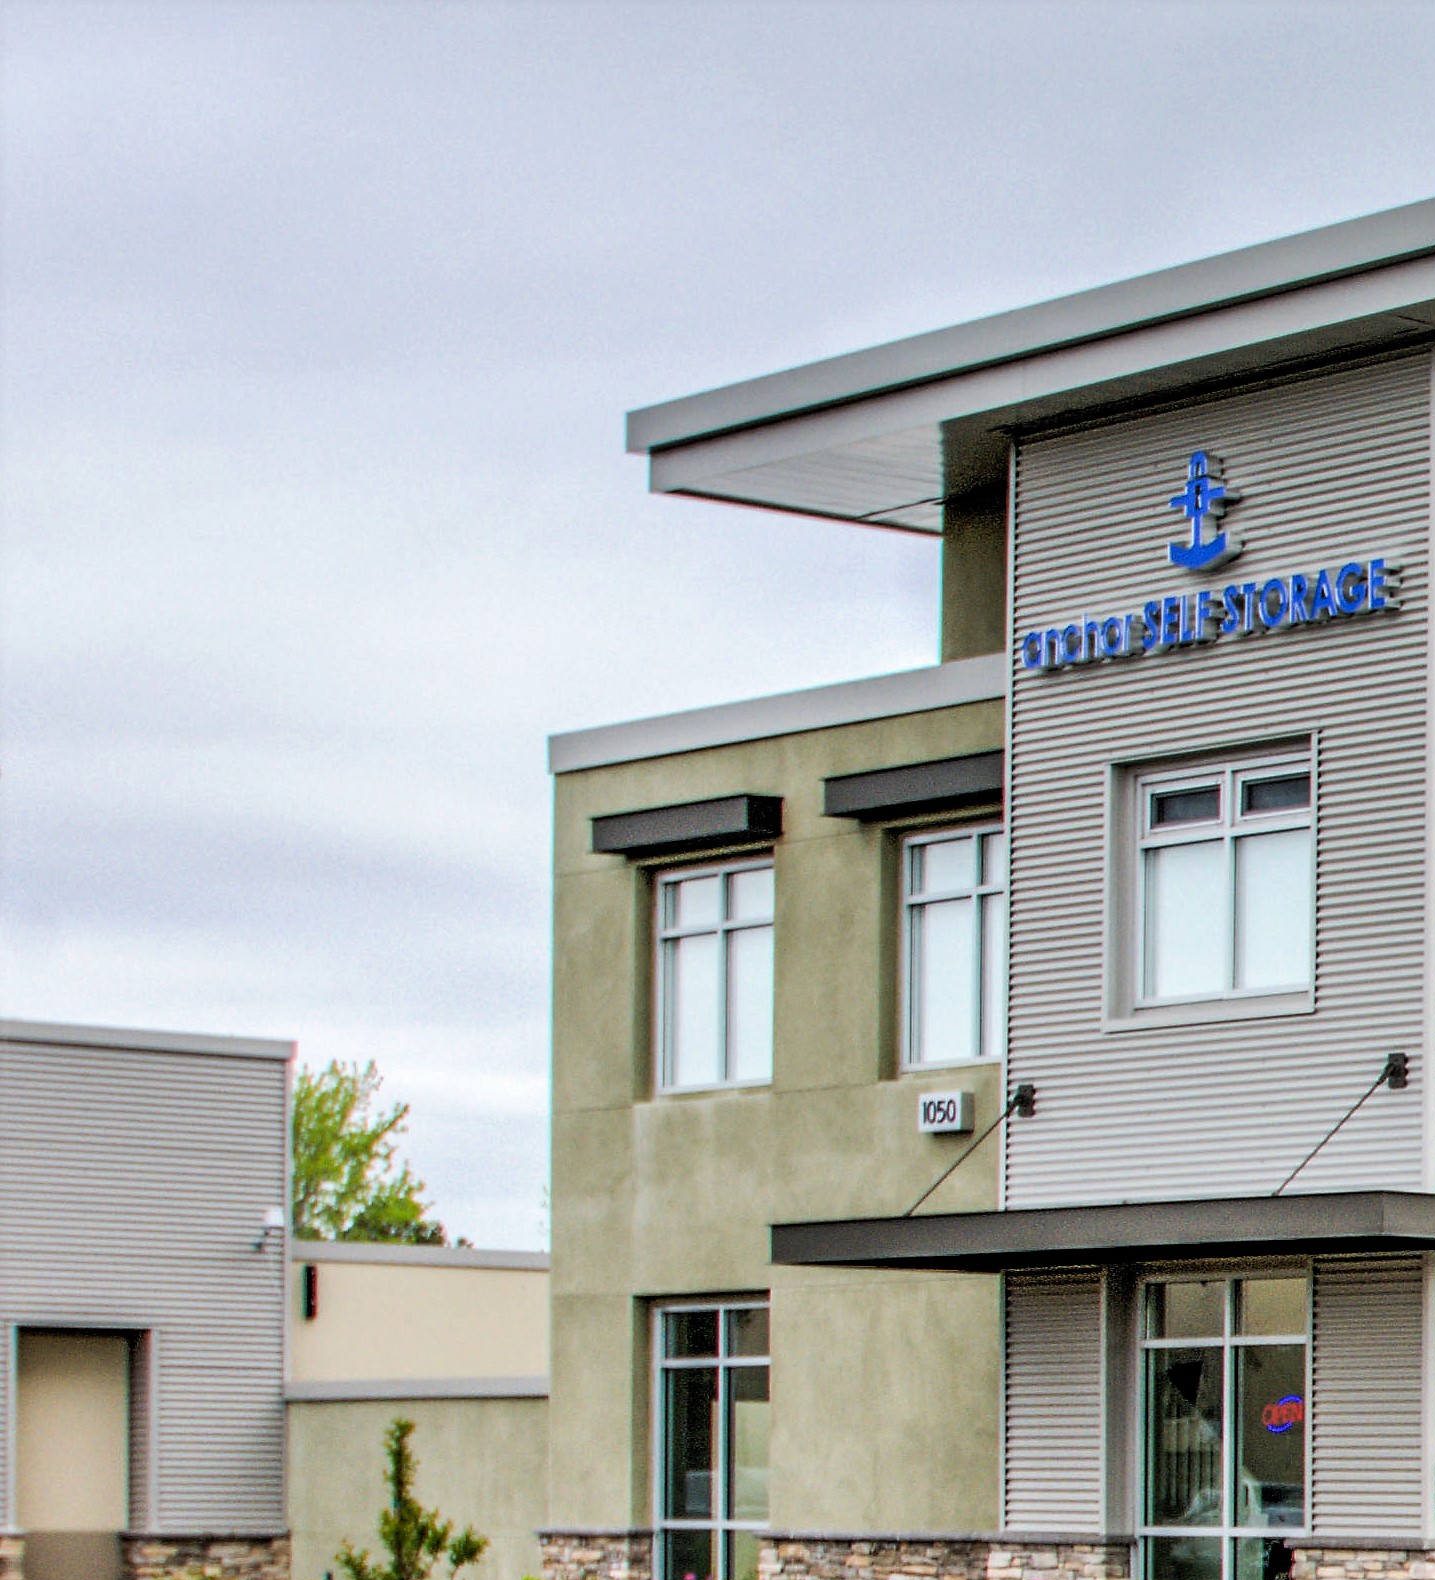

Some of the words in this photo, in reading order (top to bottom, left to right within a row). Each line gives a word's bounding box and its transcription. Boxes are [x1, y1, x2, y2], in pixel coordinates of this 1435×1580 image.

[1020, 610, 1134, 669] anchor
[1142, 591, 1213, 651] SELF
[1220, 558, 1388, 635] STORAGE
[923, 1099, 957, 1124] 1050
[1262, 1402, 1303, 1427] OPEN
